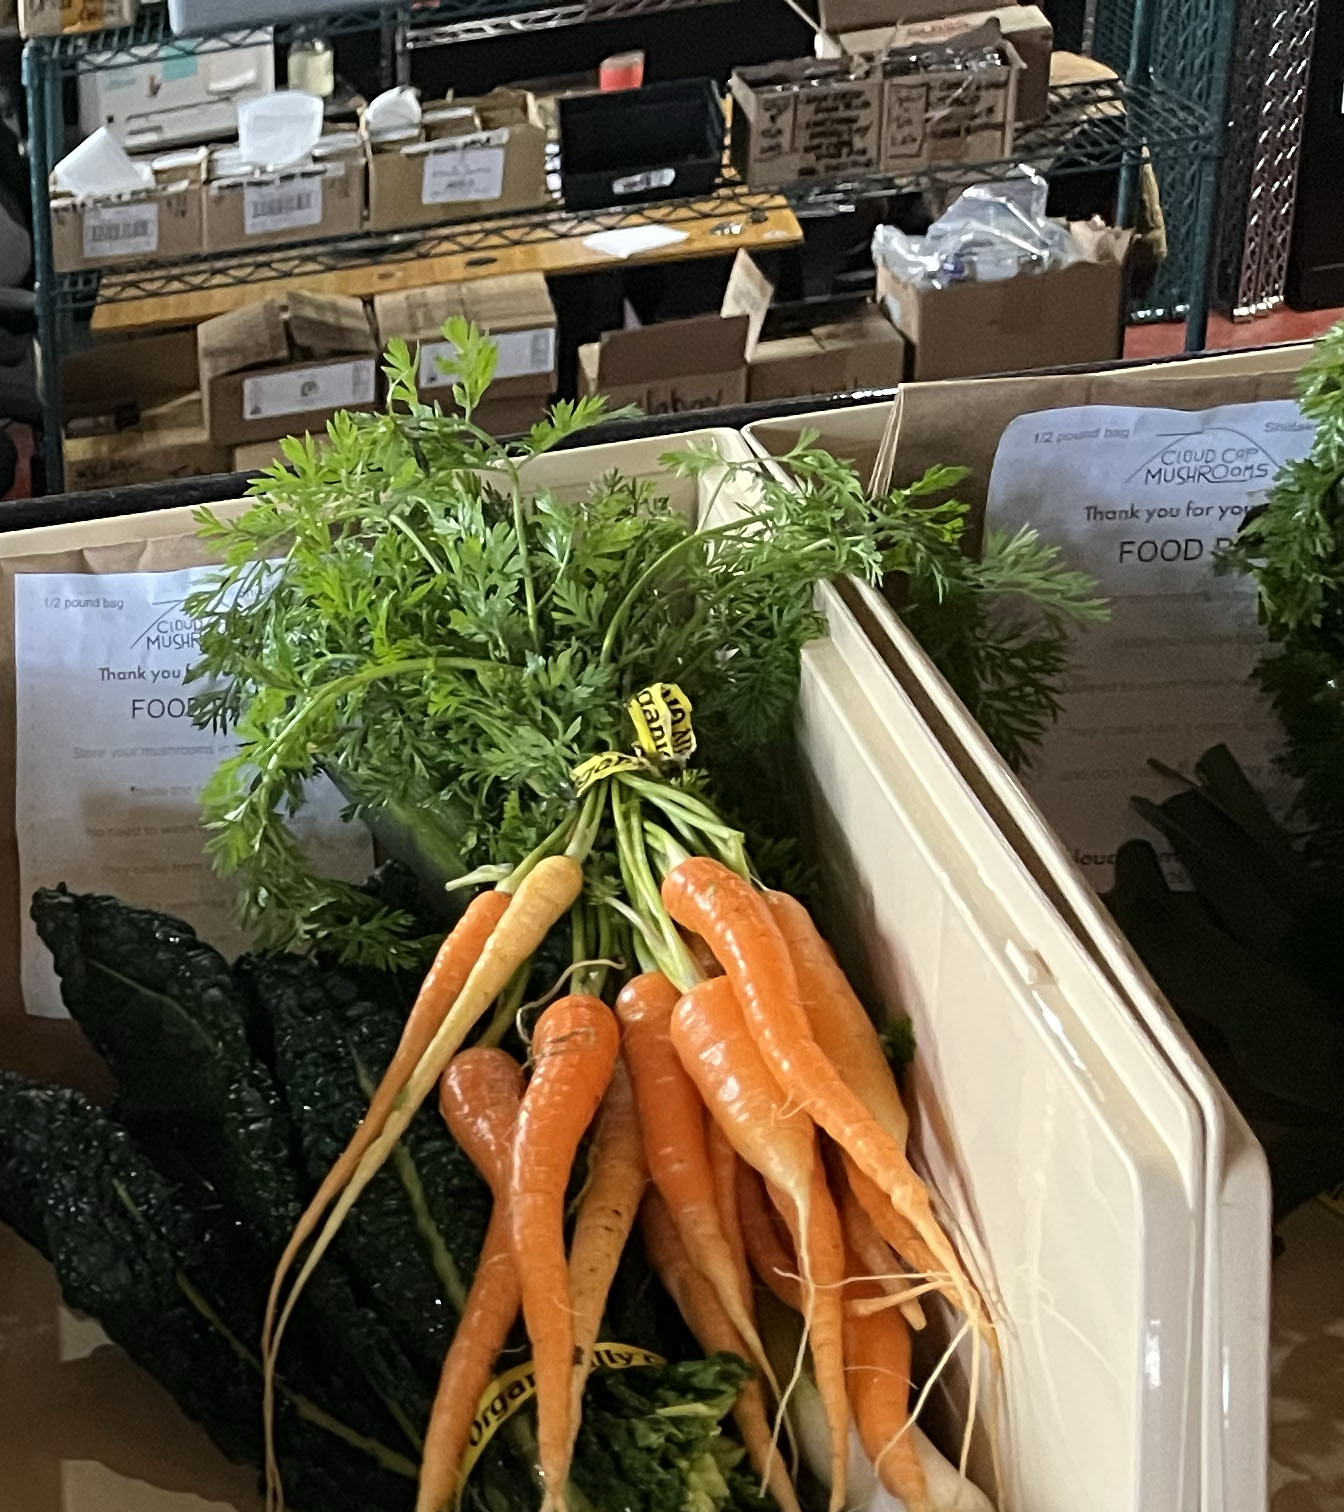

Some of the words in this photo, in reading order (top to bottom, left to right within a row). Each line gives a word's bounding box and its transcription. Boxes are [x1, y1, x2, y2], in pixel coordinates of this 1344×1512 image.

[1145, 463, 1269, 485] MUSHROOMS
[1084, 505, 1141, 521] Thank
[1145, 505, 1180, 524] you
[1186, 503, 1214, 518] for
[1119, 538, 1204, 564] FOOD
[64, 597, 100, 608] pound
[102, 598, 124, 610] bag
[98, 667, 146, 681] Thank
[151, 668, 181, 683] you
